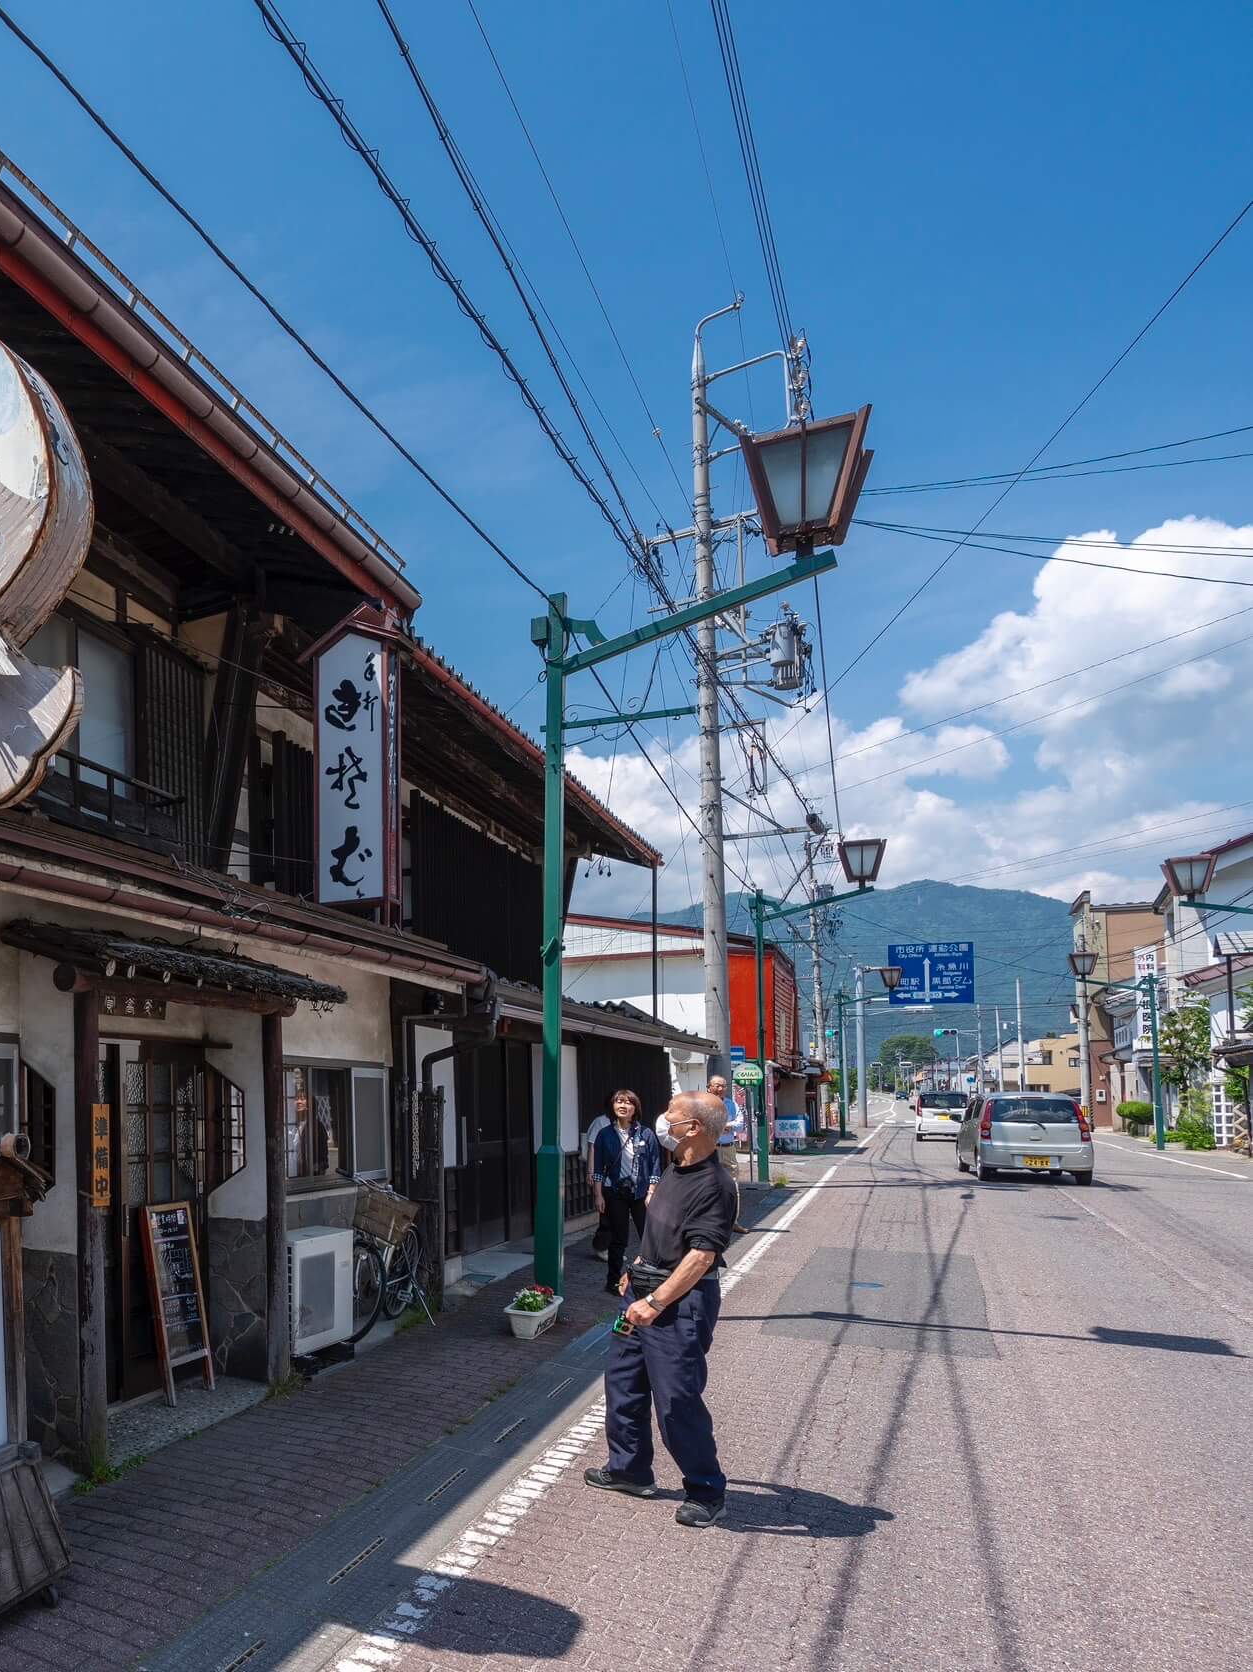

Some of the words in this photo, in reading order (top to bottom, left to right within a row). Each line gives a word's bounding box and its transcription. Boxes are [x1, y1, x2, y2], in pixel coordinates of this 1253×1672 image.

[895, 945, 924, 954] 市役所
[936, 962, 969, 971] 糸魚川
[1137, 954, 1146, 972] 外科
[1145, 954, 1154, 971] 内科
[931, 977, 972, 985] 黒部ダム
[95, 1116, 108, 1197] 準備中
